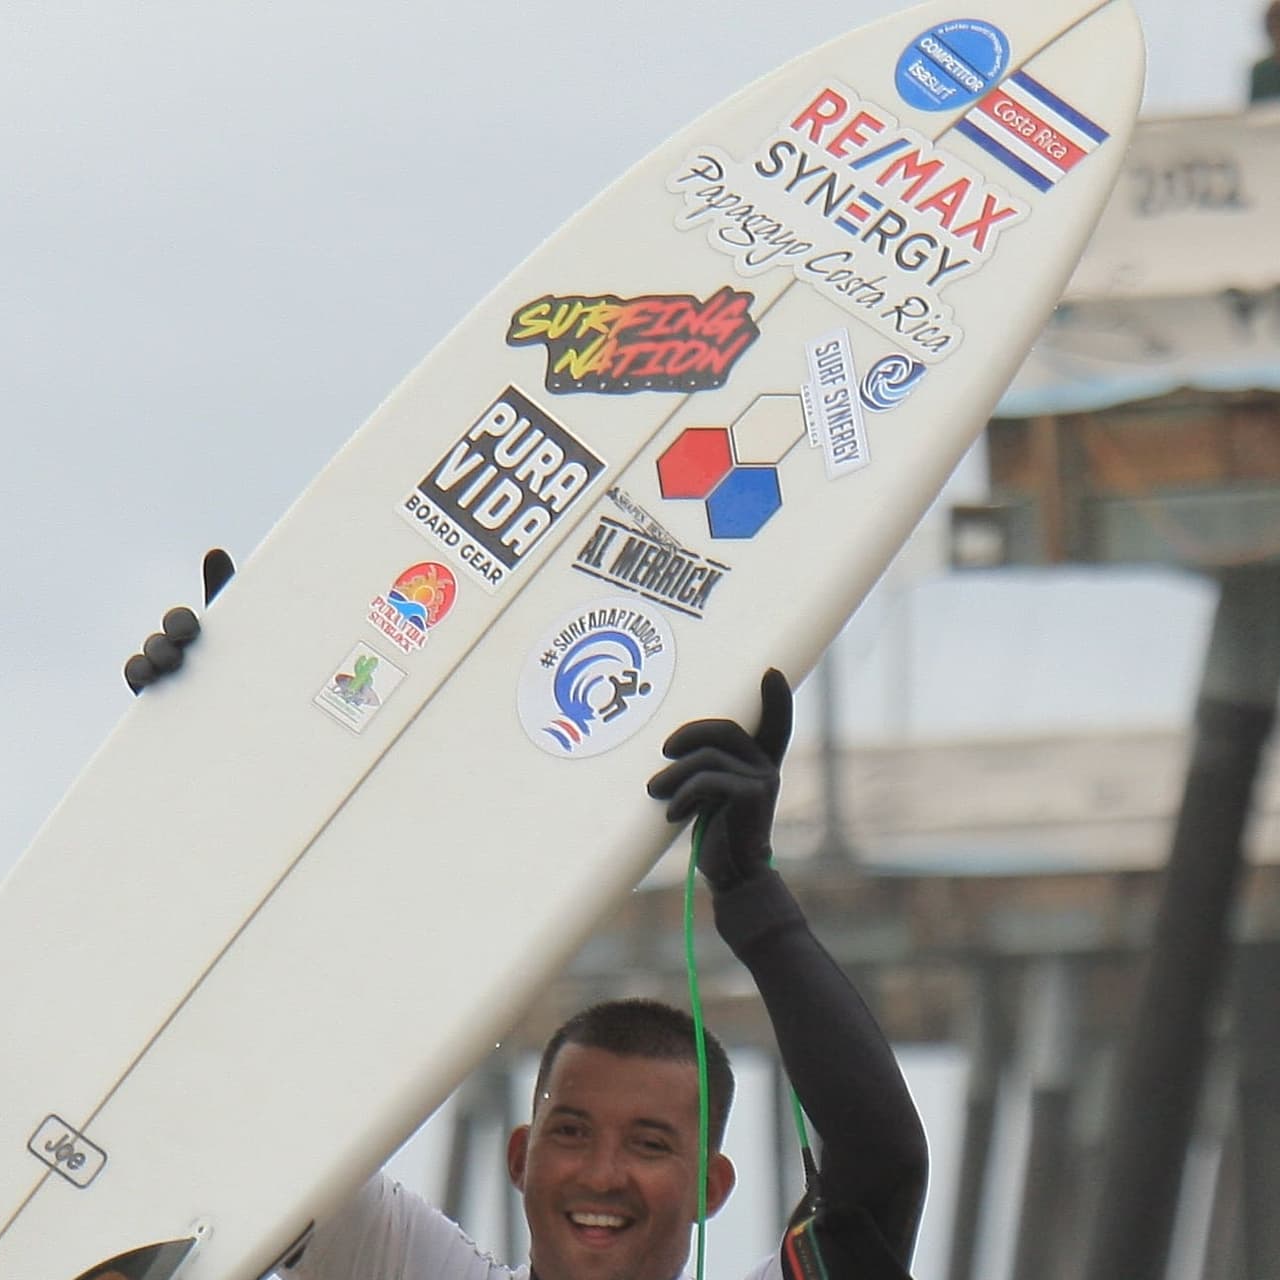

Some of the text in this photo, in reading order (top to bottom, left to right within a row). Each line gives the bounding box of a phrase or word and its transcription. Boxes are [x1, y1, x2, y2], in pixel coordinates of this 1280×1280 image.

[907, 60, 957, 100] isasurf
[920, 37, 985, 93] COMPETITOR
[993, 99, 1068, 159] Costa Rica
[789, 87, 1019, 253] RE/MAX
[754, 140, 972, 288] SYNERGY
[677, 154, 952, 354] Papagayo Costa Rica
[513, 294, 749, 344] SURFING
[554, 333, 751, 380] NATION
[815, 340, 860, 464] SURF SYNERGY
[468, 402, 589, 513] PURA
[435, 441, 552, 557] VIDA
[404, 495, 504, 585] BOARD GEAR
[609, 536, 723, 610] MERRICK
[371, 595, 402, 625] PURA
[45, 1134, 86, 1170] Joe
